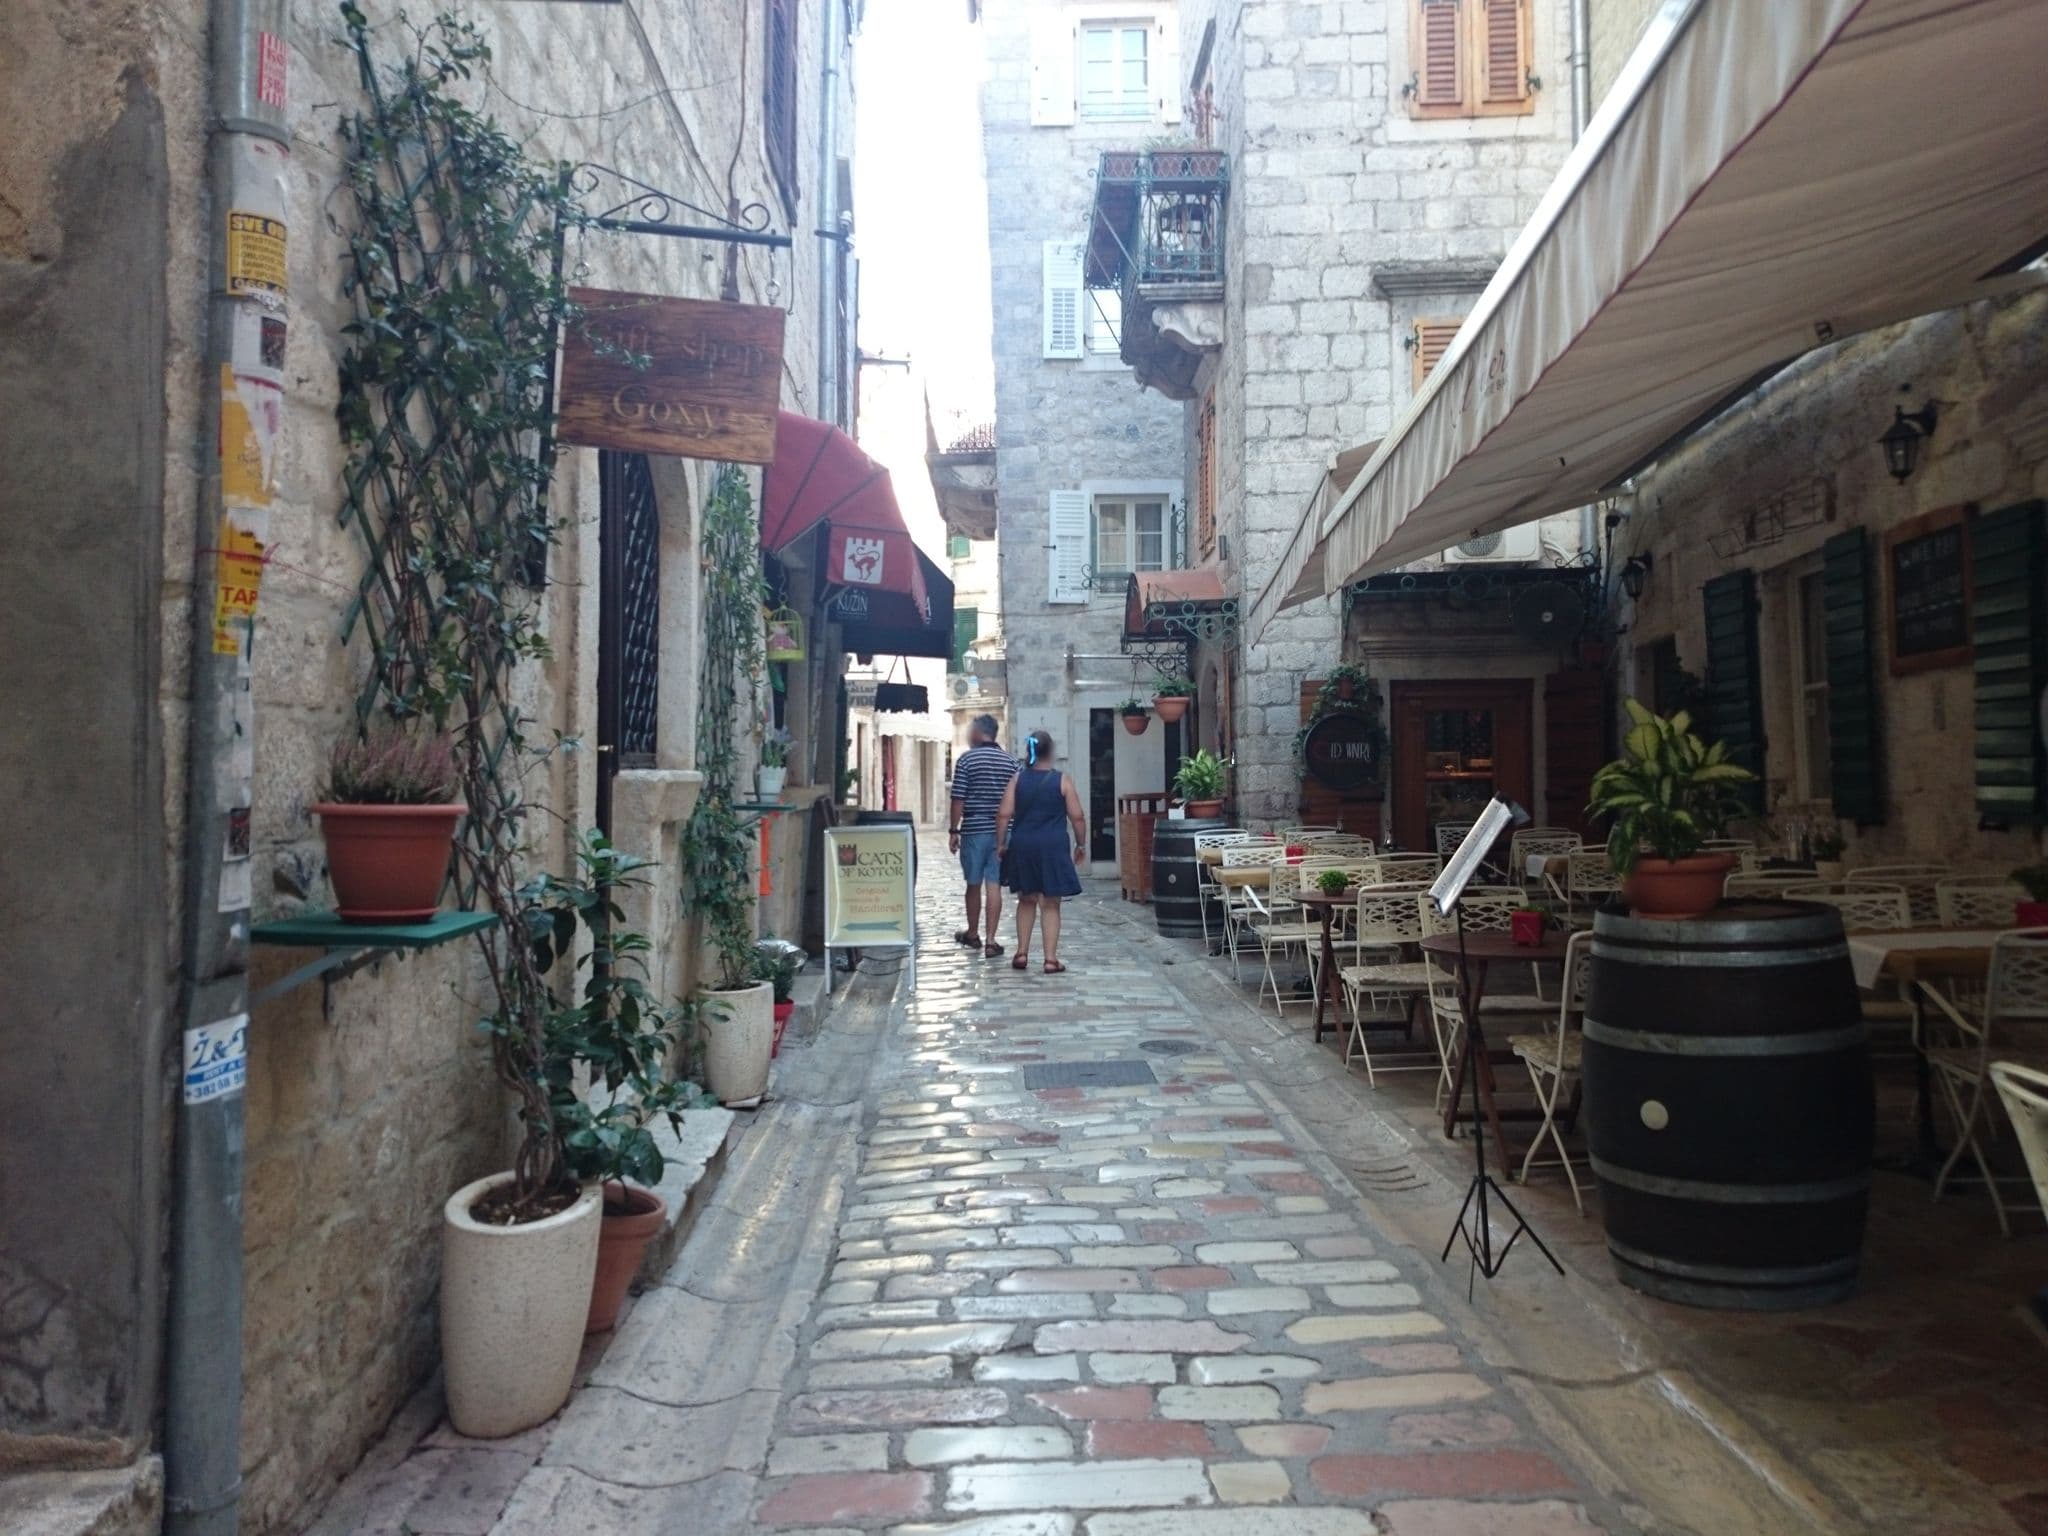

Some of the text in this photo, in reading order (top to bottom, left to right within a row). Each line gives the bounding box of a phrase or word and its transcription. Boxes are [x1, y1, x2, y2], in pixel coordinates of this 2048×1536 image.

[231, 215, 264, 234] SVE
[857, 851, 904, 866] CATS
[839, 866, 904, 878] OF KOTOR
